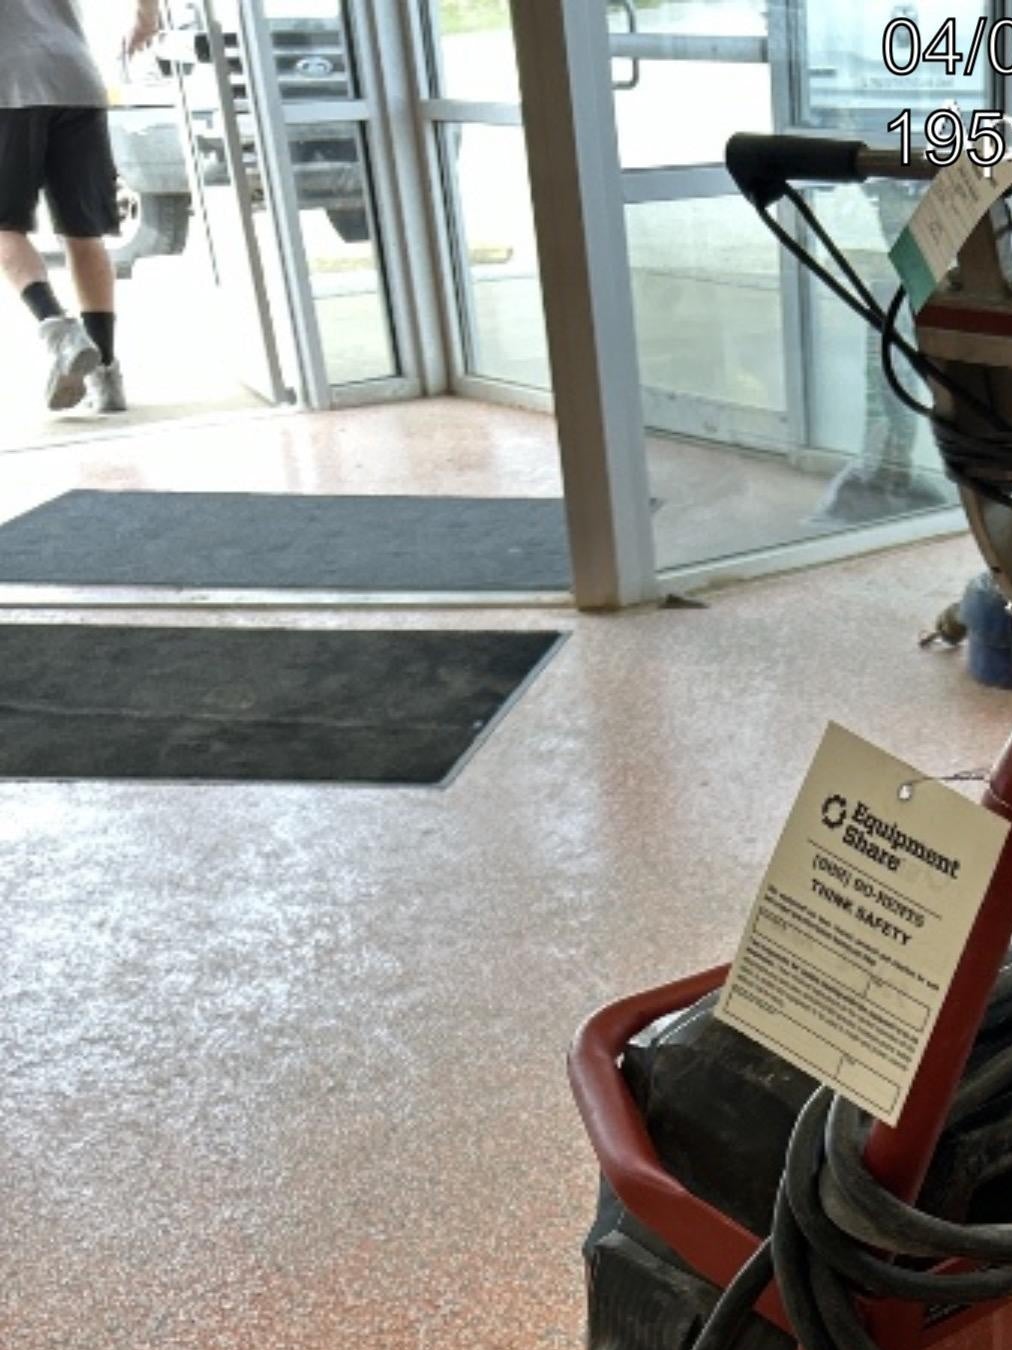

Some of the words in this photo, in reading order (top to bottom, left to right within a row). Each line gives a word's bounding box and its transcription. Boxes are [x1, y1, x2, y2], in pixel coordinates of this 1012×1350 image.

[842, 825, 902, 874] Share
[851, 799, 961, 879] Equipment
[811, 878, 854, 921] THINK
[854, 906, 913, 947] SAFETY
